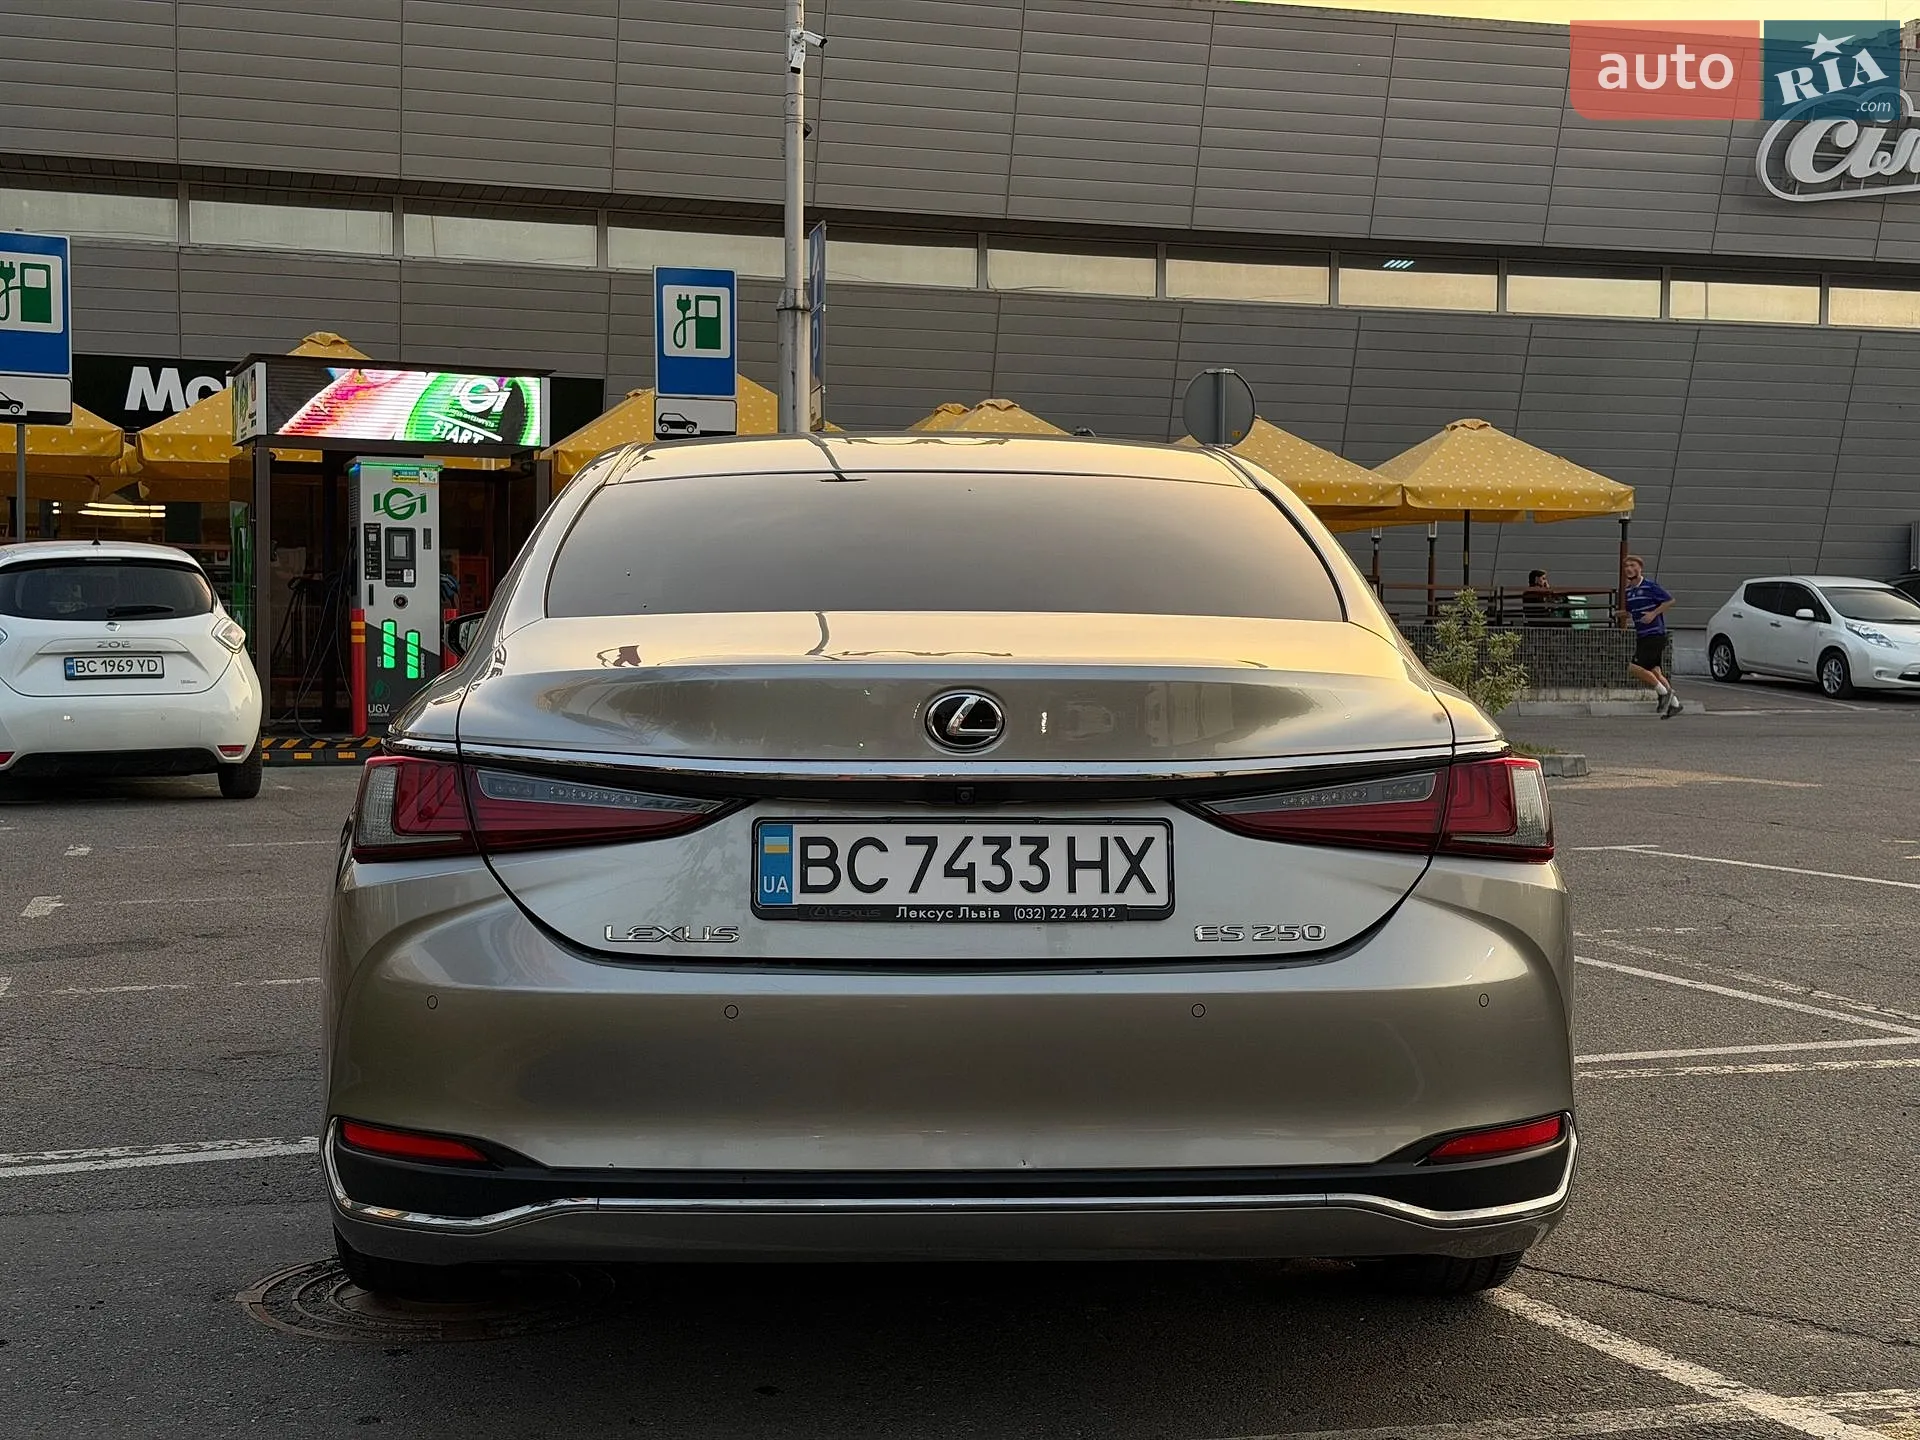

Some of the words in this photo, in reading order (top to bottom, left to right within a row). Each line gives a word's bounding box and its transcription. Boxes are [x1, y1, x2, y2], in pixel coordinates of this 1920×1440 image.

[431, 419, 485, 444] START
[75, 660, 98, 674] BC
[100, 659, 134, 674] 1969
[137, 659, 158, 673] YD
[367, 703, 391, 714] UGV
[799, 836, 889, 894] BC
[905, 835, 1051, 894] 7433
[1066, 835, 1157, 894] HX
[763, 875, 790, 894] UA
[896, 906, 954, 922] Лексус
[957, 906, 1001, 919] Львів
[1013, 907, 1046, 921] (032)
[1050, 908, 1067, 919] 22
[1071, 908, 1088, 919] 44
[1091, 906, 1116, 919] 212
[604, 924, 740, 944] LEXUS
[1194, 924, 1245, 942] ES
[1251, 924, 1327, 942] 250
